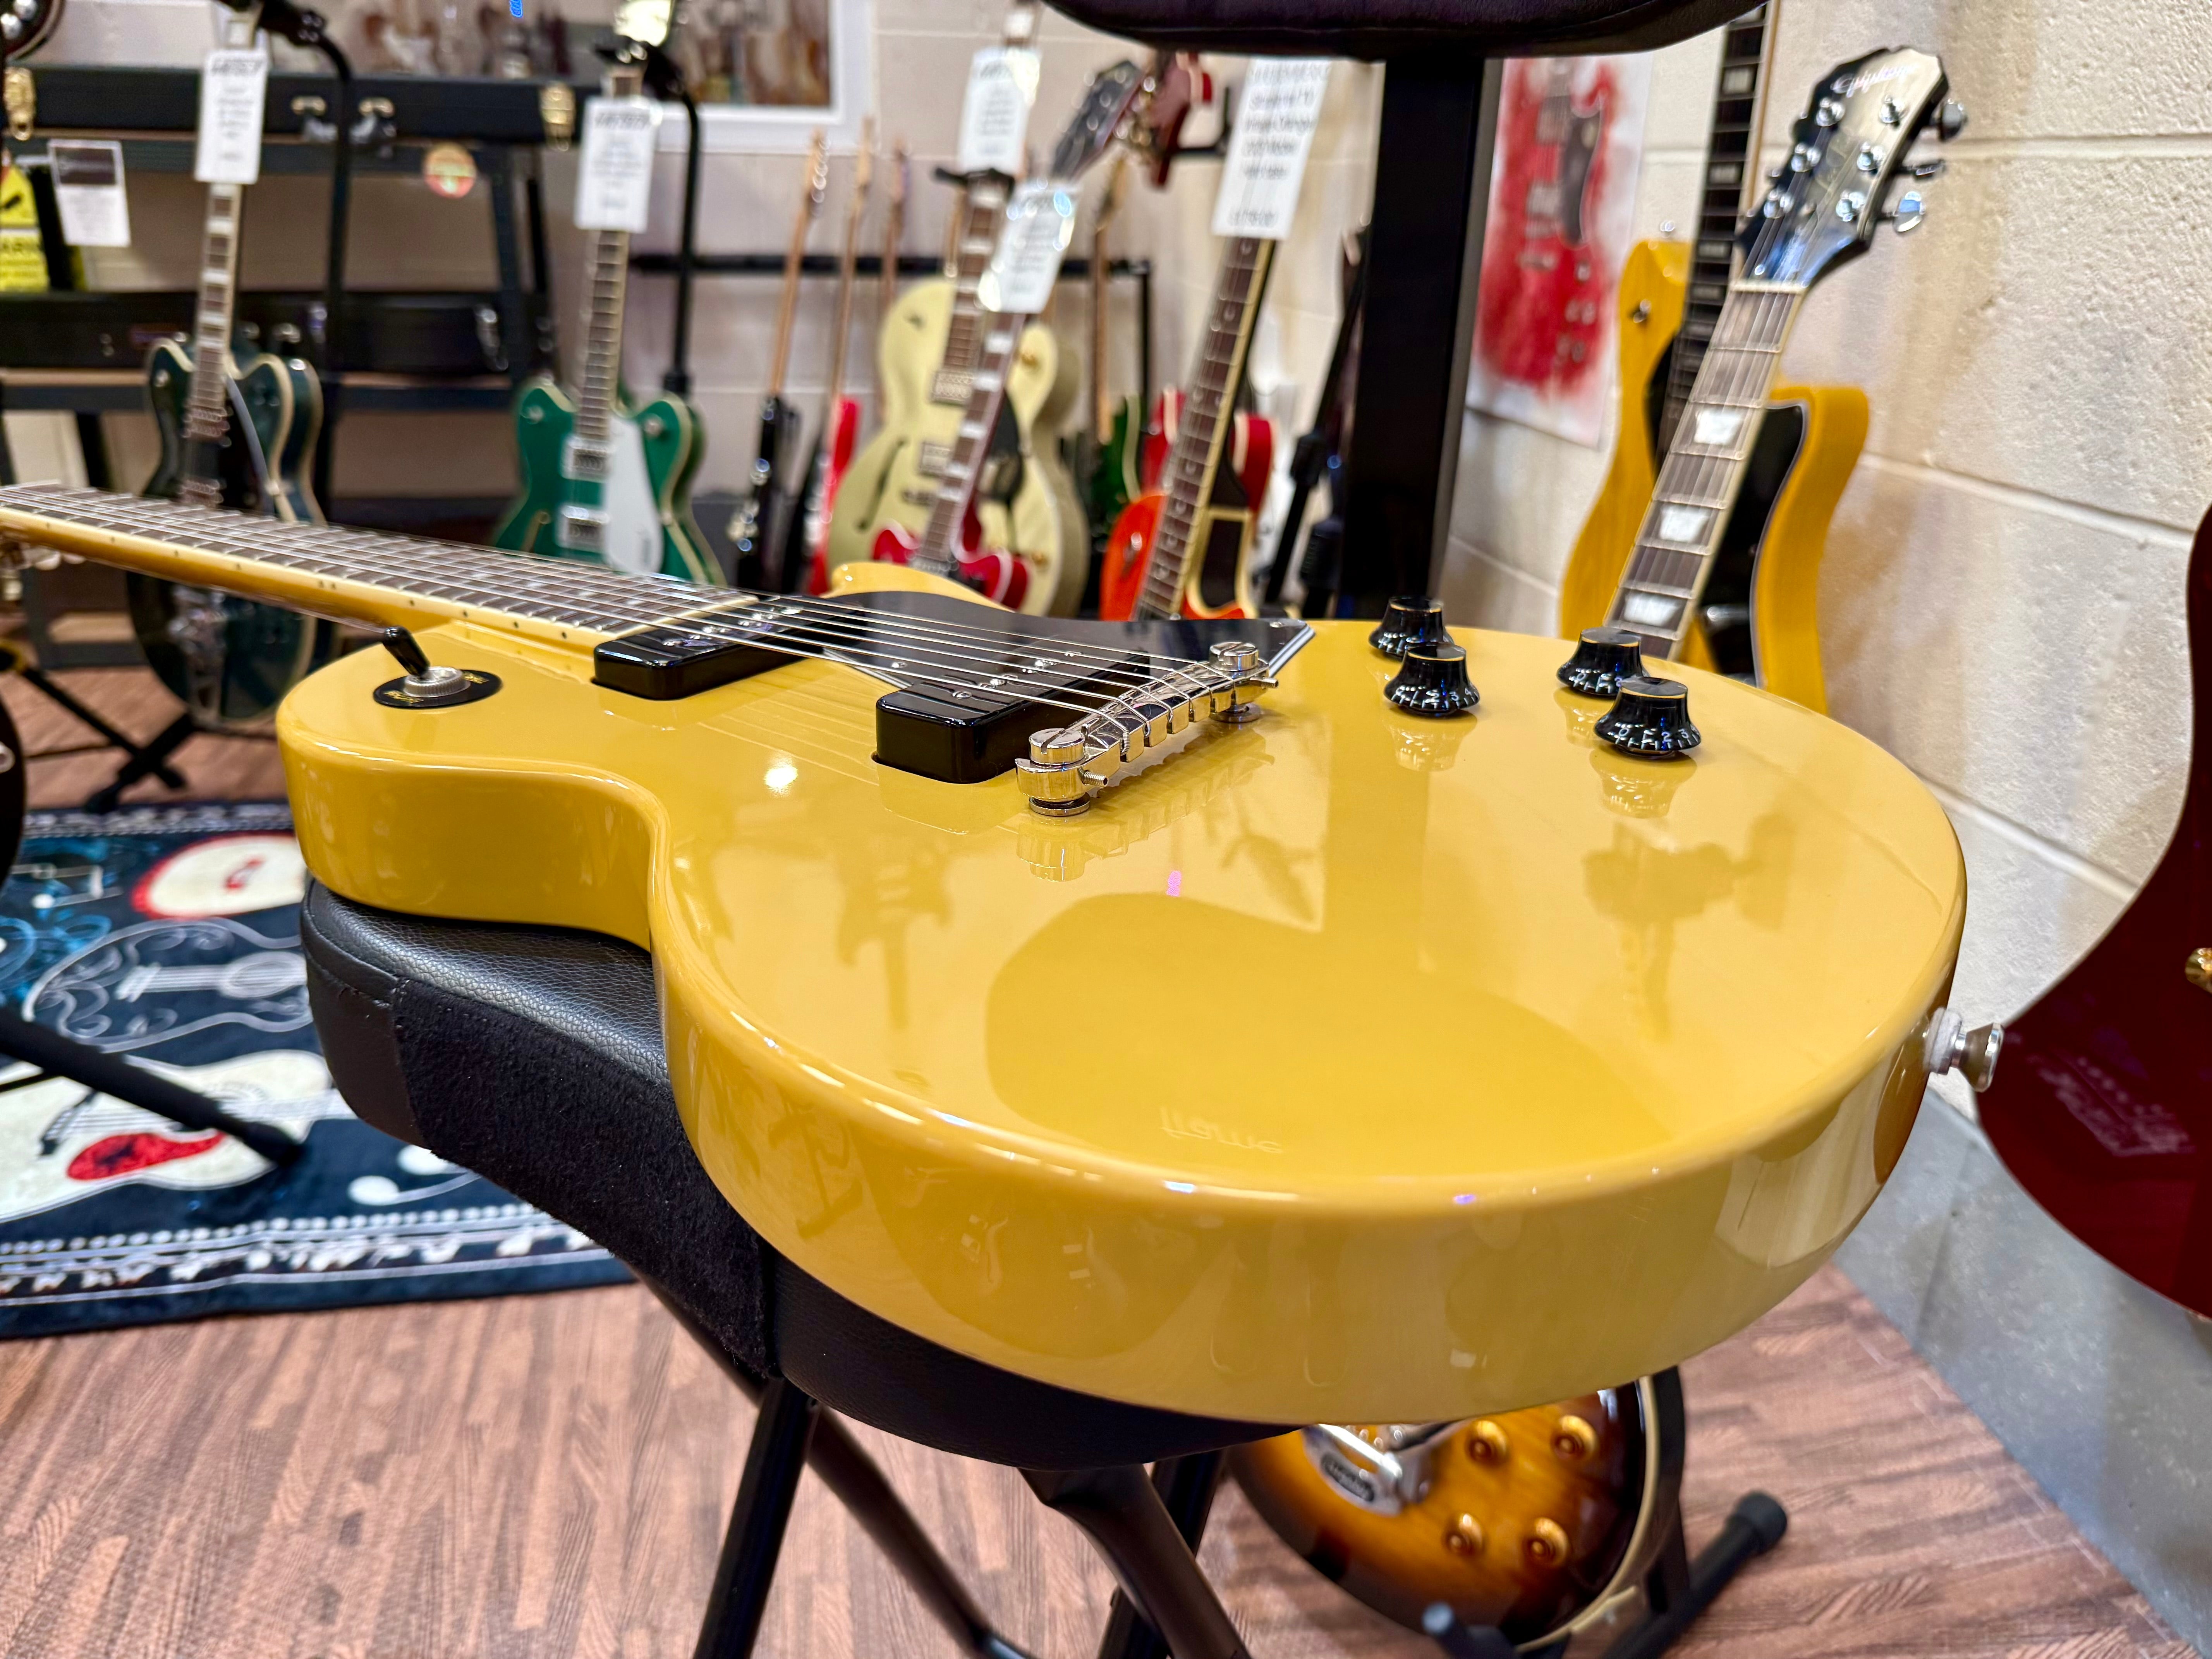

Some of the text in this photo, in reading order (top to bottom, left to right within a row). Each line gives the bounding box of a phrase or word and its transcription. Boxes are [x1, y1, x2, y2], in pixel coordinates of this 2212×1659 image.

[1449, 691, 1459, 701] 3
[1465, 688, 1472, 696] 4
[1619, 728, 1629, 737] 0
[1661, 732, 1672, 742] 2
[1678, 728, 1688, 739] 3
